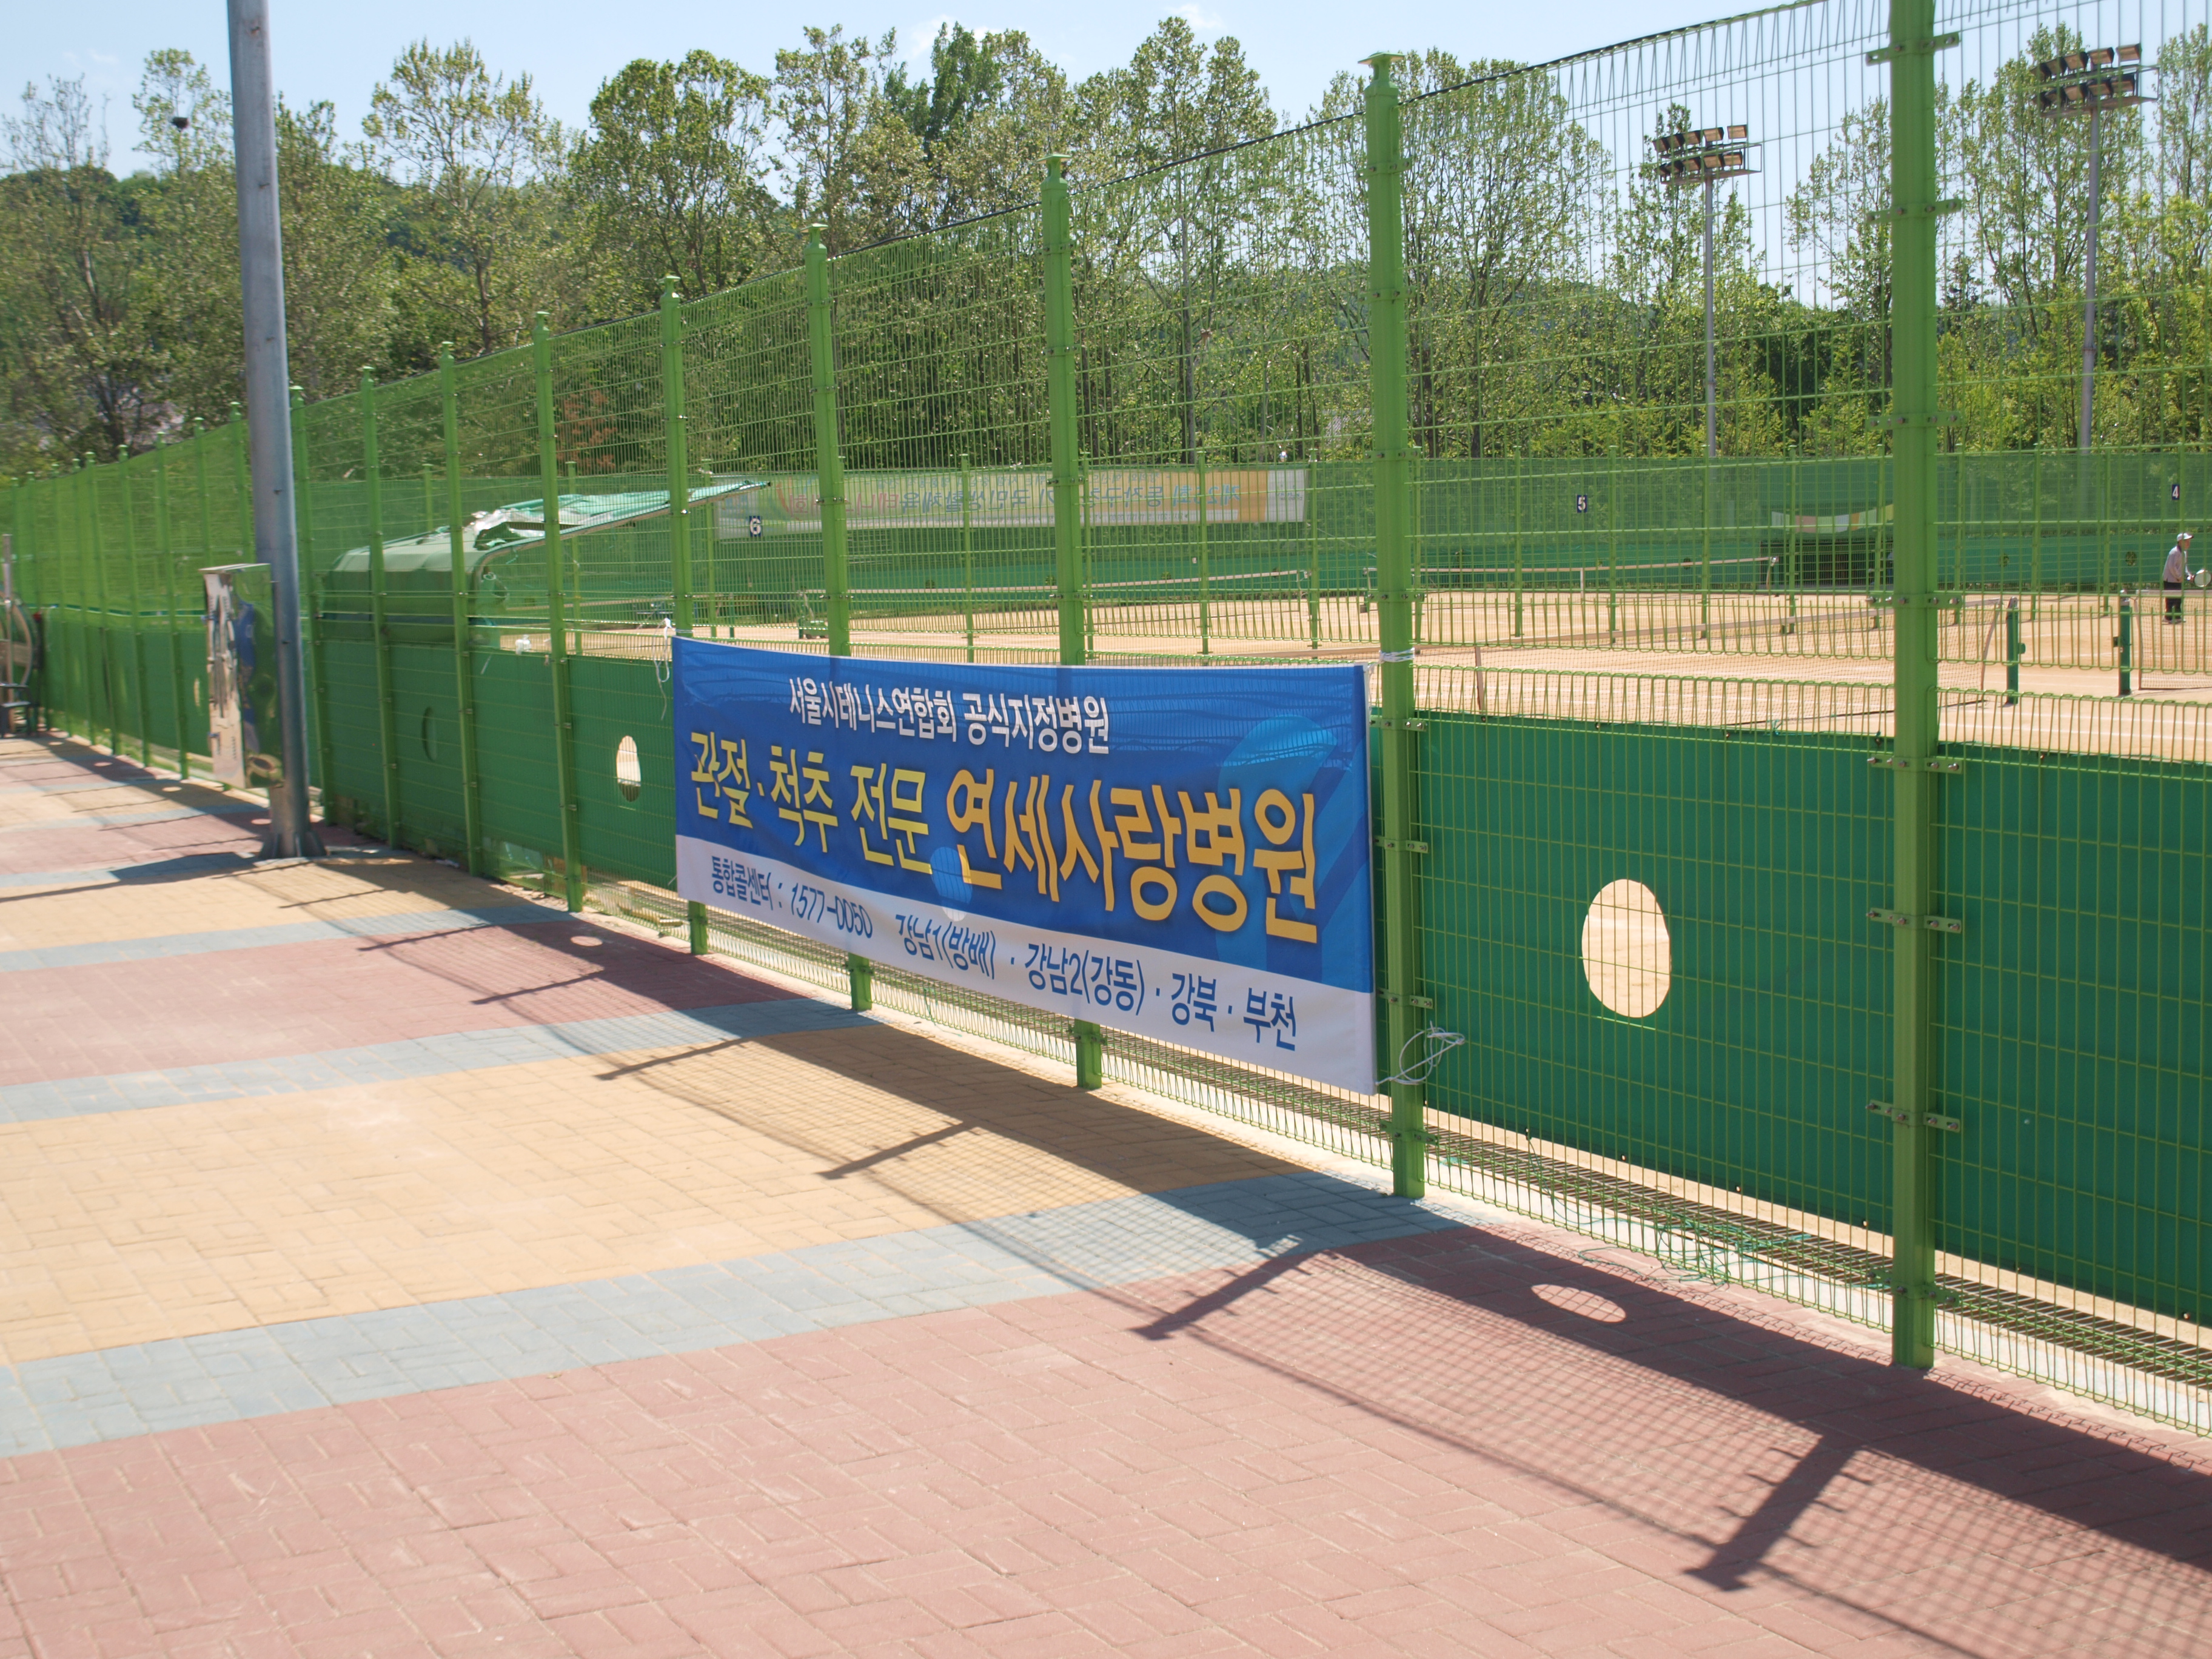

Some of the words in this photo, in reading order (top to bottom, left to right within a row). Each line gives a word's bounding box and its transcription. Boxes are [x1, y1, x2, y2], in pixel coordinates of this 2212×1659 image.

[1578, 497, 1586, 511] 5
[2172, 486, 2179, 498] 4
[749, 518, 761, 535] 6
[789, 677, 957, 743] 서울시테니스연합회
[962, 692, 1109, 755] 공식지정병원
[850, 763, 933, 875] 전문
[947, 768, 1317, 943] 연세사랑병원
[711, 856, 773, 911] 통합콜센터
[791, 882, 873, 939] 1577-0050
[895, 914, 996, 980] 강남1(방배)
[1025, 943, 1145, 1016] 강남2(강동)
[1171, 973, 1218, 1032] 강북
[1243, 987, 1297, 1051] 부천
